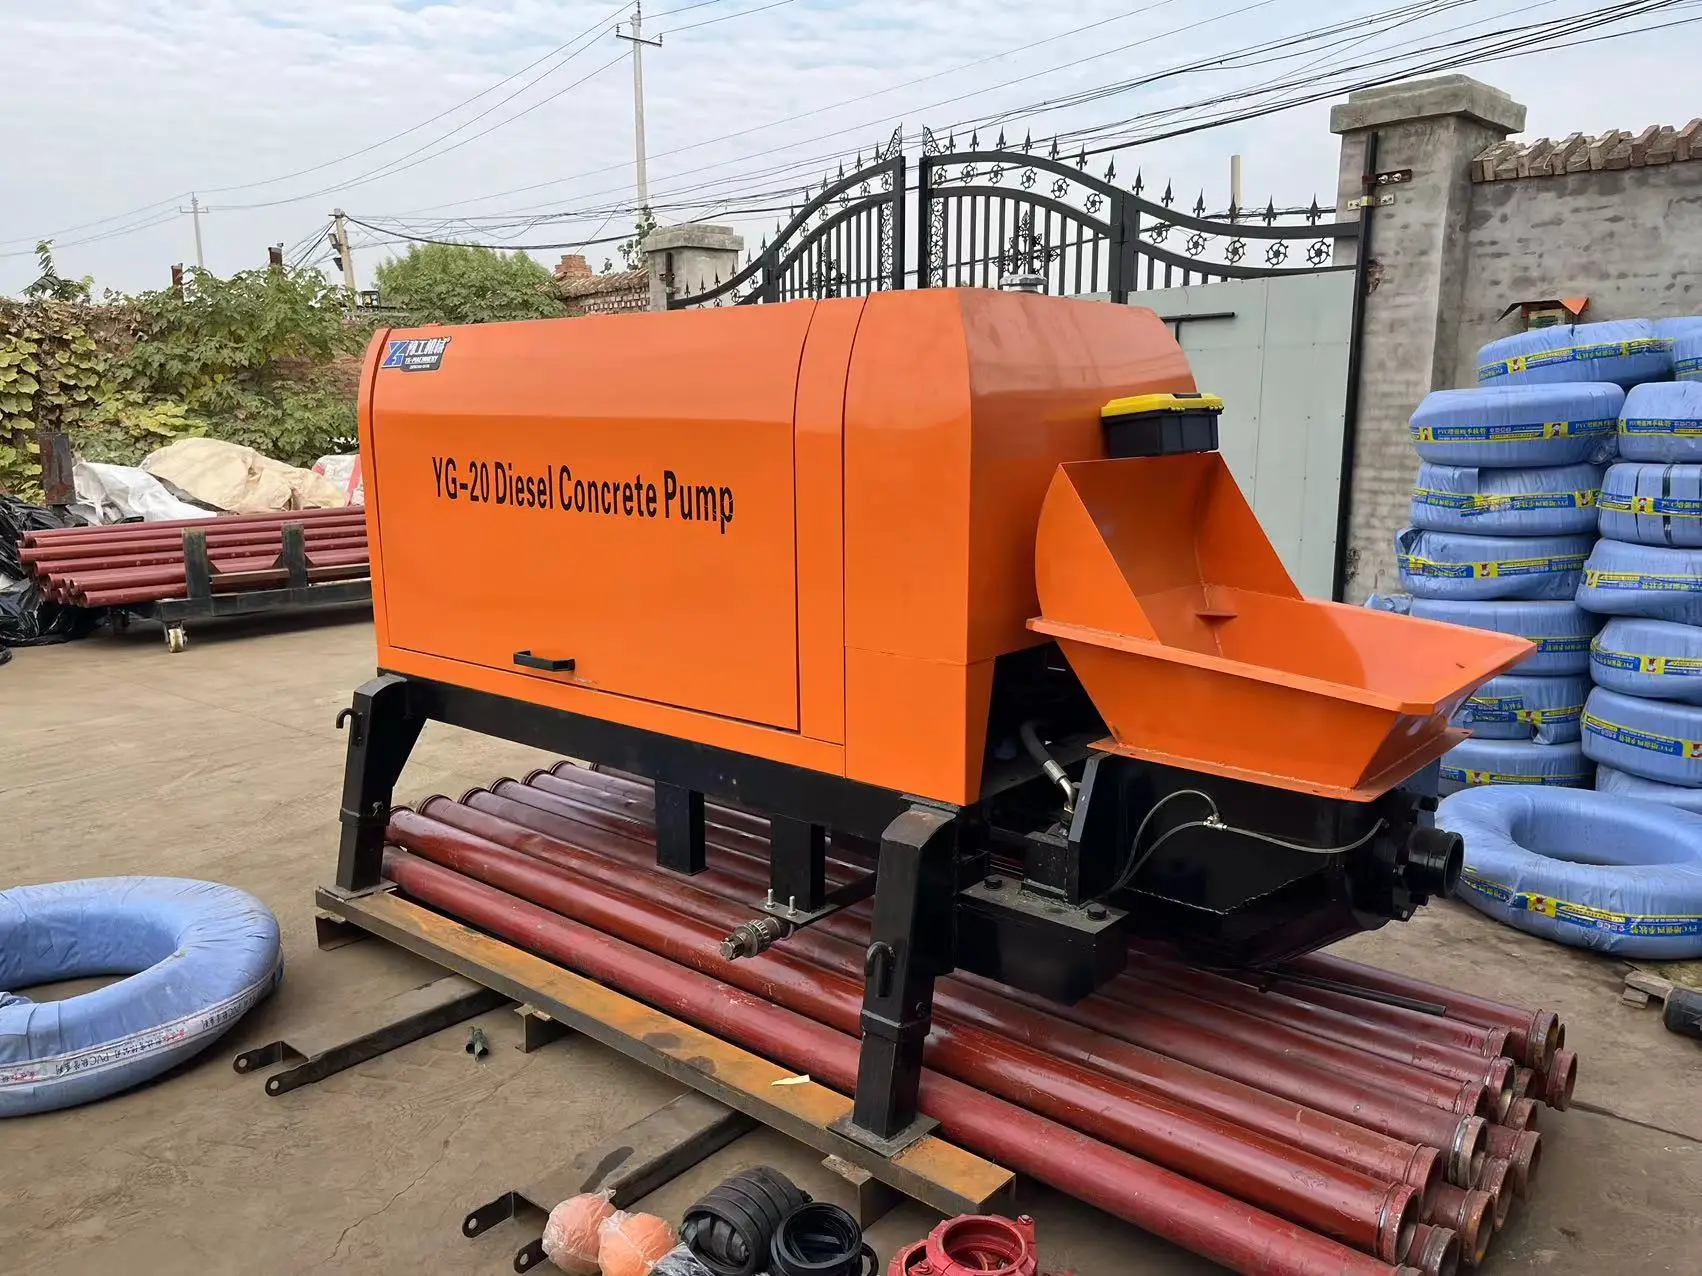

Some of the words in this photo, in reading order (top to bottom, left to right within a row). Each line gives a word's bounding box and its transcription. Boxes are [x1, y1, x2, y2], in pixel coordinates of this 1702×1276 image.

[432, 456, 490, 503] YG-20
[494, 461, 553, 510] Diesel
[559, 464, 657, 518] Concrete
[663, 470, 734, 535] Pump
